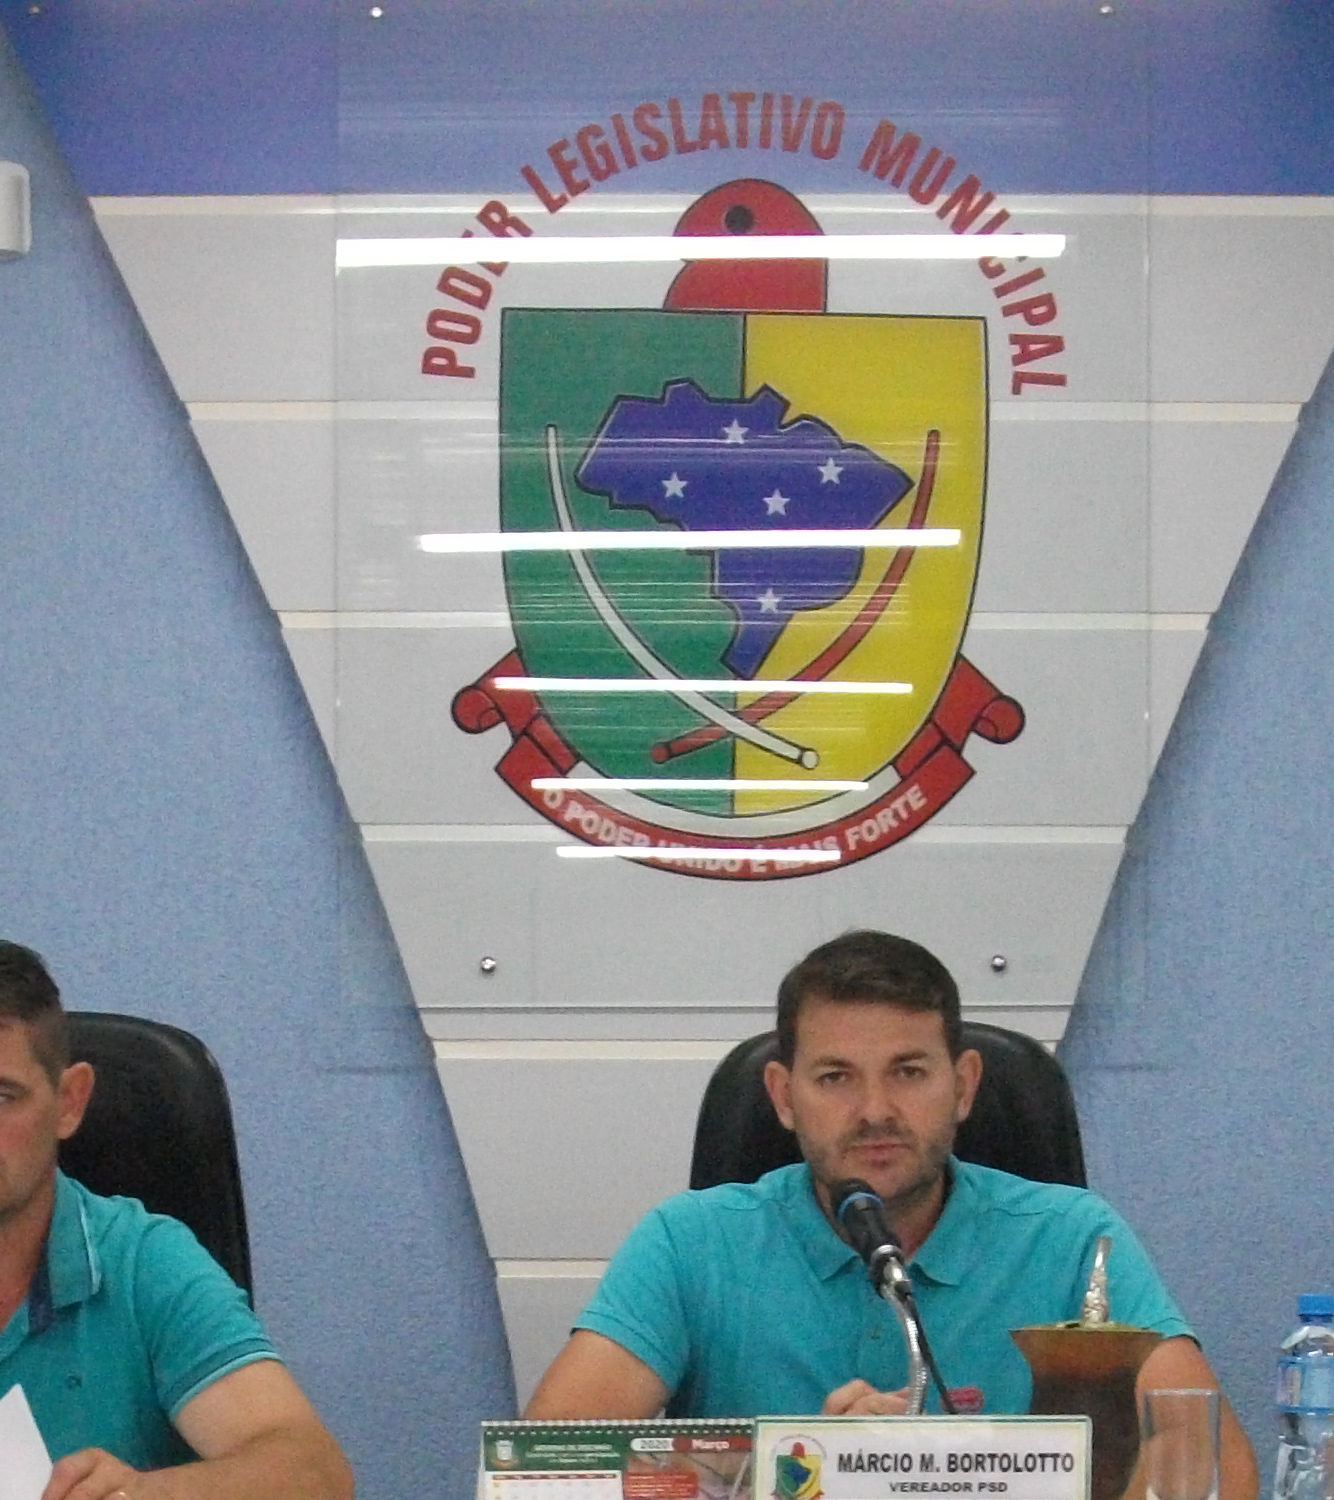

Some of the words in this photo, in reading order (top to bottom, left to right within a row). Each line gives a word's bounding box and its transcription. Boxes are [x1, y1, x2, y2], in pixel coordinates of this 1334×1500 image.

[421, 200, 534, 379] PODR
[520, 91, 845, 214] LEGISLATIVO
[844, 782, 929, 852] FORTE
[691, 1439, 730, 1451] Março
[837, 1448, 913, 1474] MÁRCIO
[919, 1452, 941, 1473] M.
[947, 1452, 1075, 1473] BORTOLOTTO
[889, 1481, 973, 1493] VEREADOR
[977, 1481, 1008, 1493] PSD
